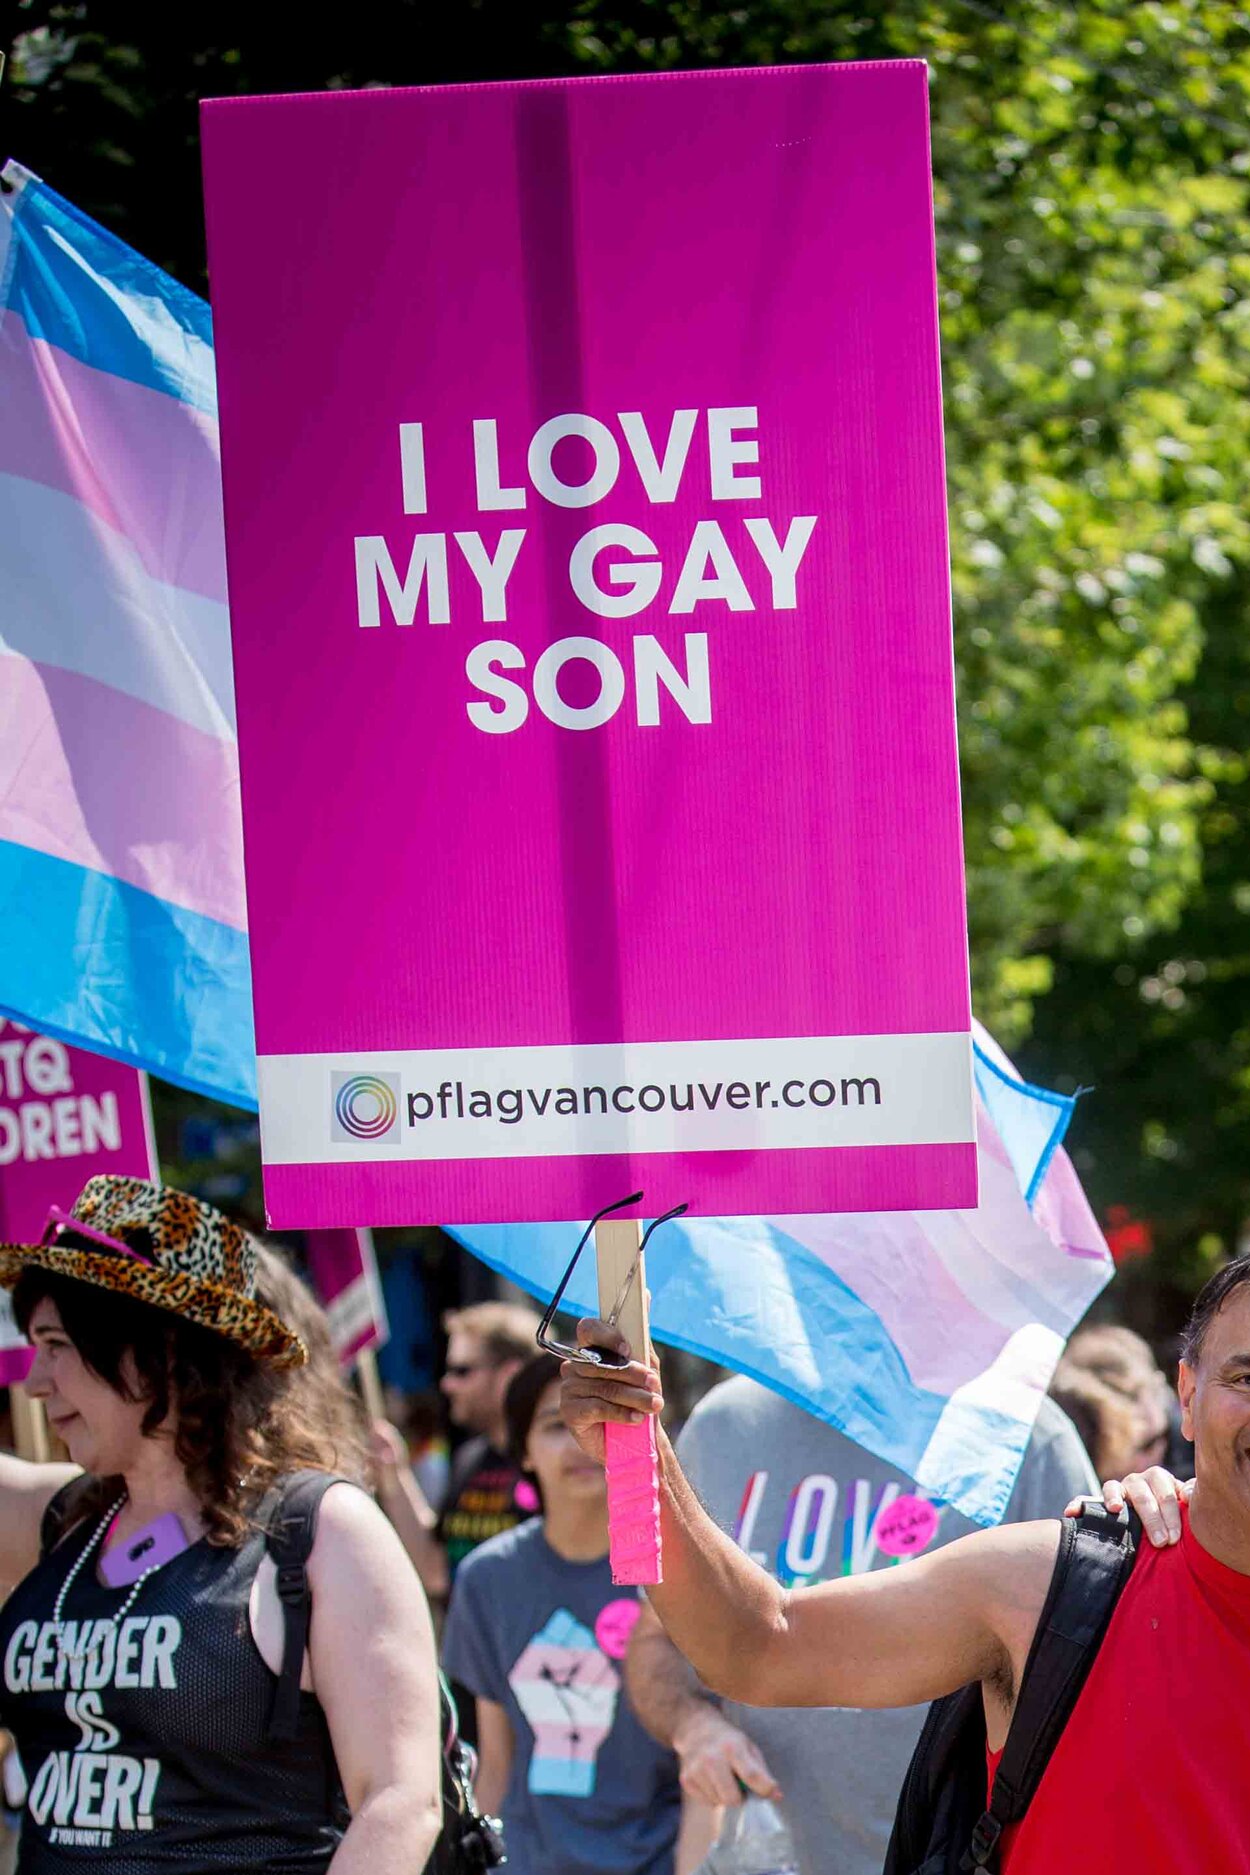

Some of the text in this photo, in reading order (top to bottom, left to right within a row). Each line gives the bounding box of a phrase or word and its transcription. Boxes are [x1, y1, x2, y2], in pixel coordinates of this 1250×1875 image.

[399, 406, 762, 515] I LOVE
[354, 515, 818, 628] MY GAY
[465, 632, 712, 734] SON
[0, 1036, 74, 1099] TQ
[406, 1074, 882, 1128] pflagvancouver.com
[737, 1471, 948, 1576] LOV
[4, 1614, 181, 1693] GENDER
[64, 1691, 121, 1751] IS
[28, 1751, 160, 1830] OVER!
[59, 1828, 75, 1845] YOU
[75, 1829, 100, 1847] WANT
